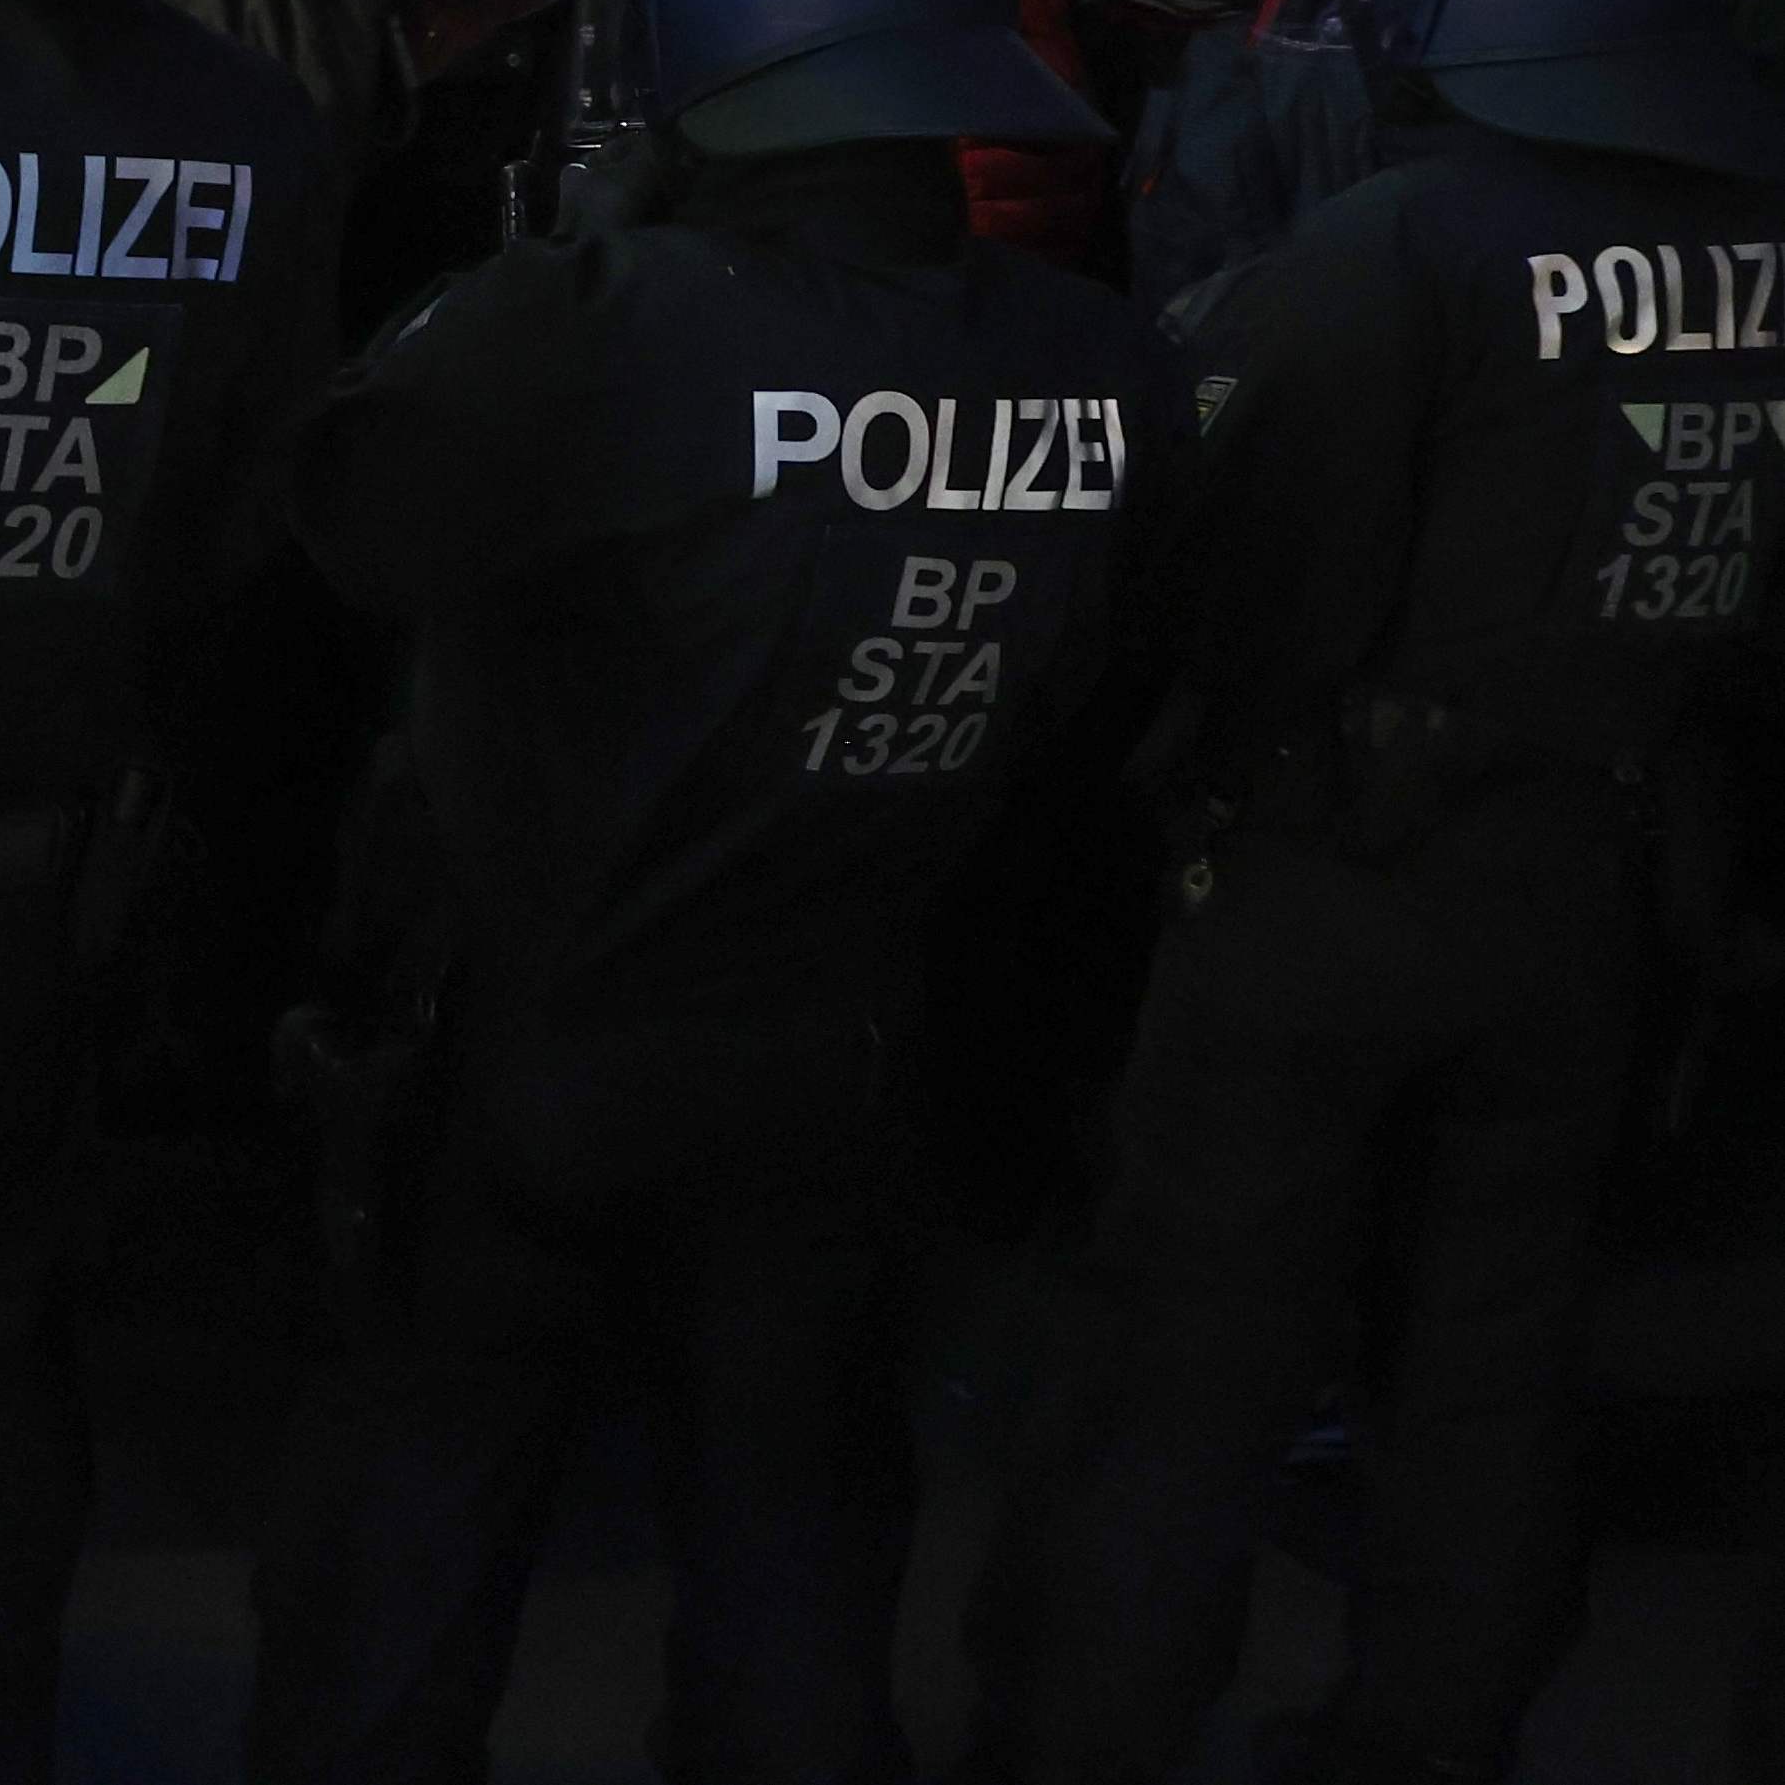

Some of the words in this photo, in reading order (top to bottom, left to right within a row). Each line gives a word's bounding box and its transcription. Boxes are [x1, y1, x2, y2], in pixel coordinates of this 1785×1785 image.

[1526, 241, 1785, 360] POLIZ
[750, 389, 1128, 512] POLIZEI
[1664, 401, 1762, 472] BP
[1621, 479, 1754, 549] STA
[889, 554, 1018, 632] BP
[1596, 552, 1751, 619] 1320
[836, 636, 1002, 706] STA
[800, 706, 989, 777] 1320
